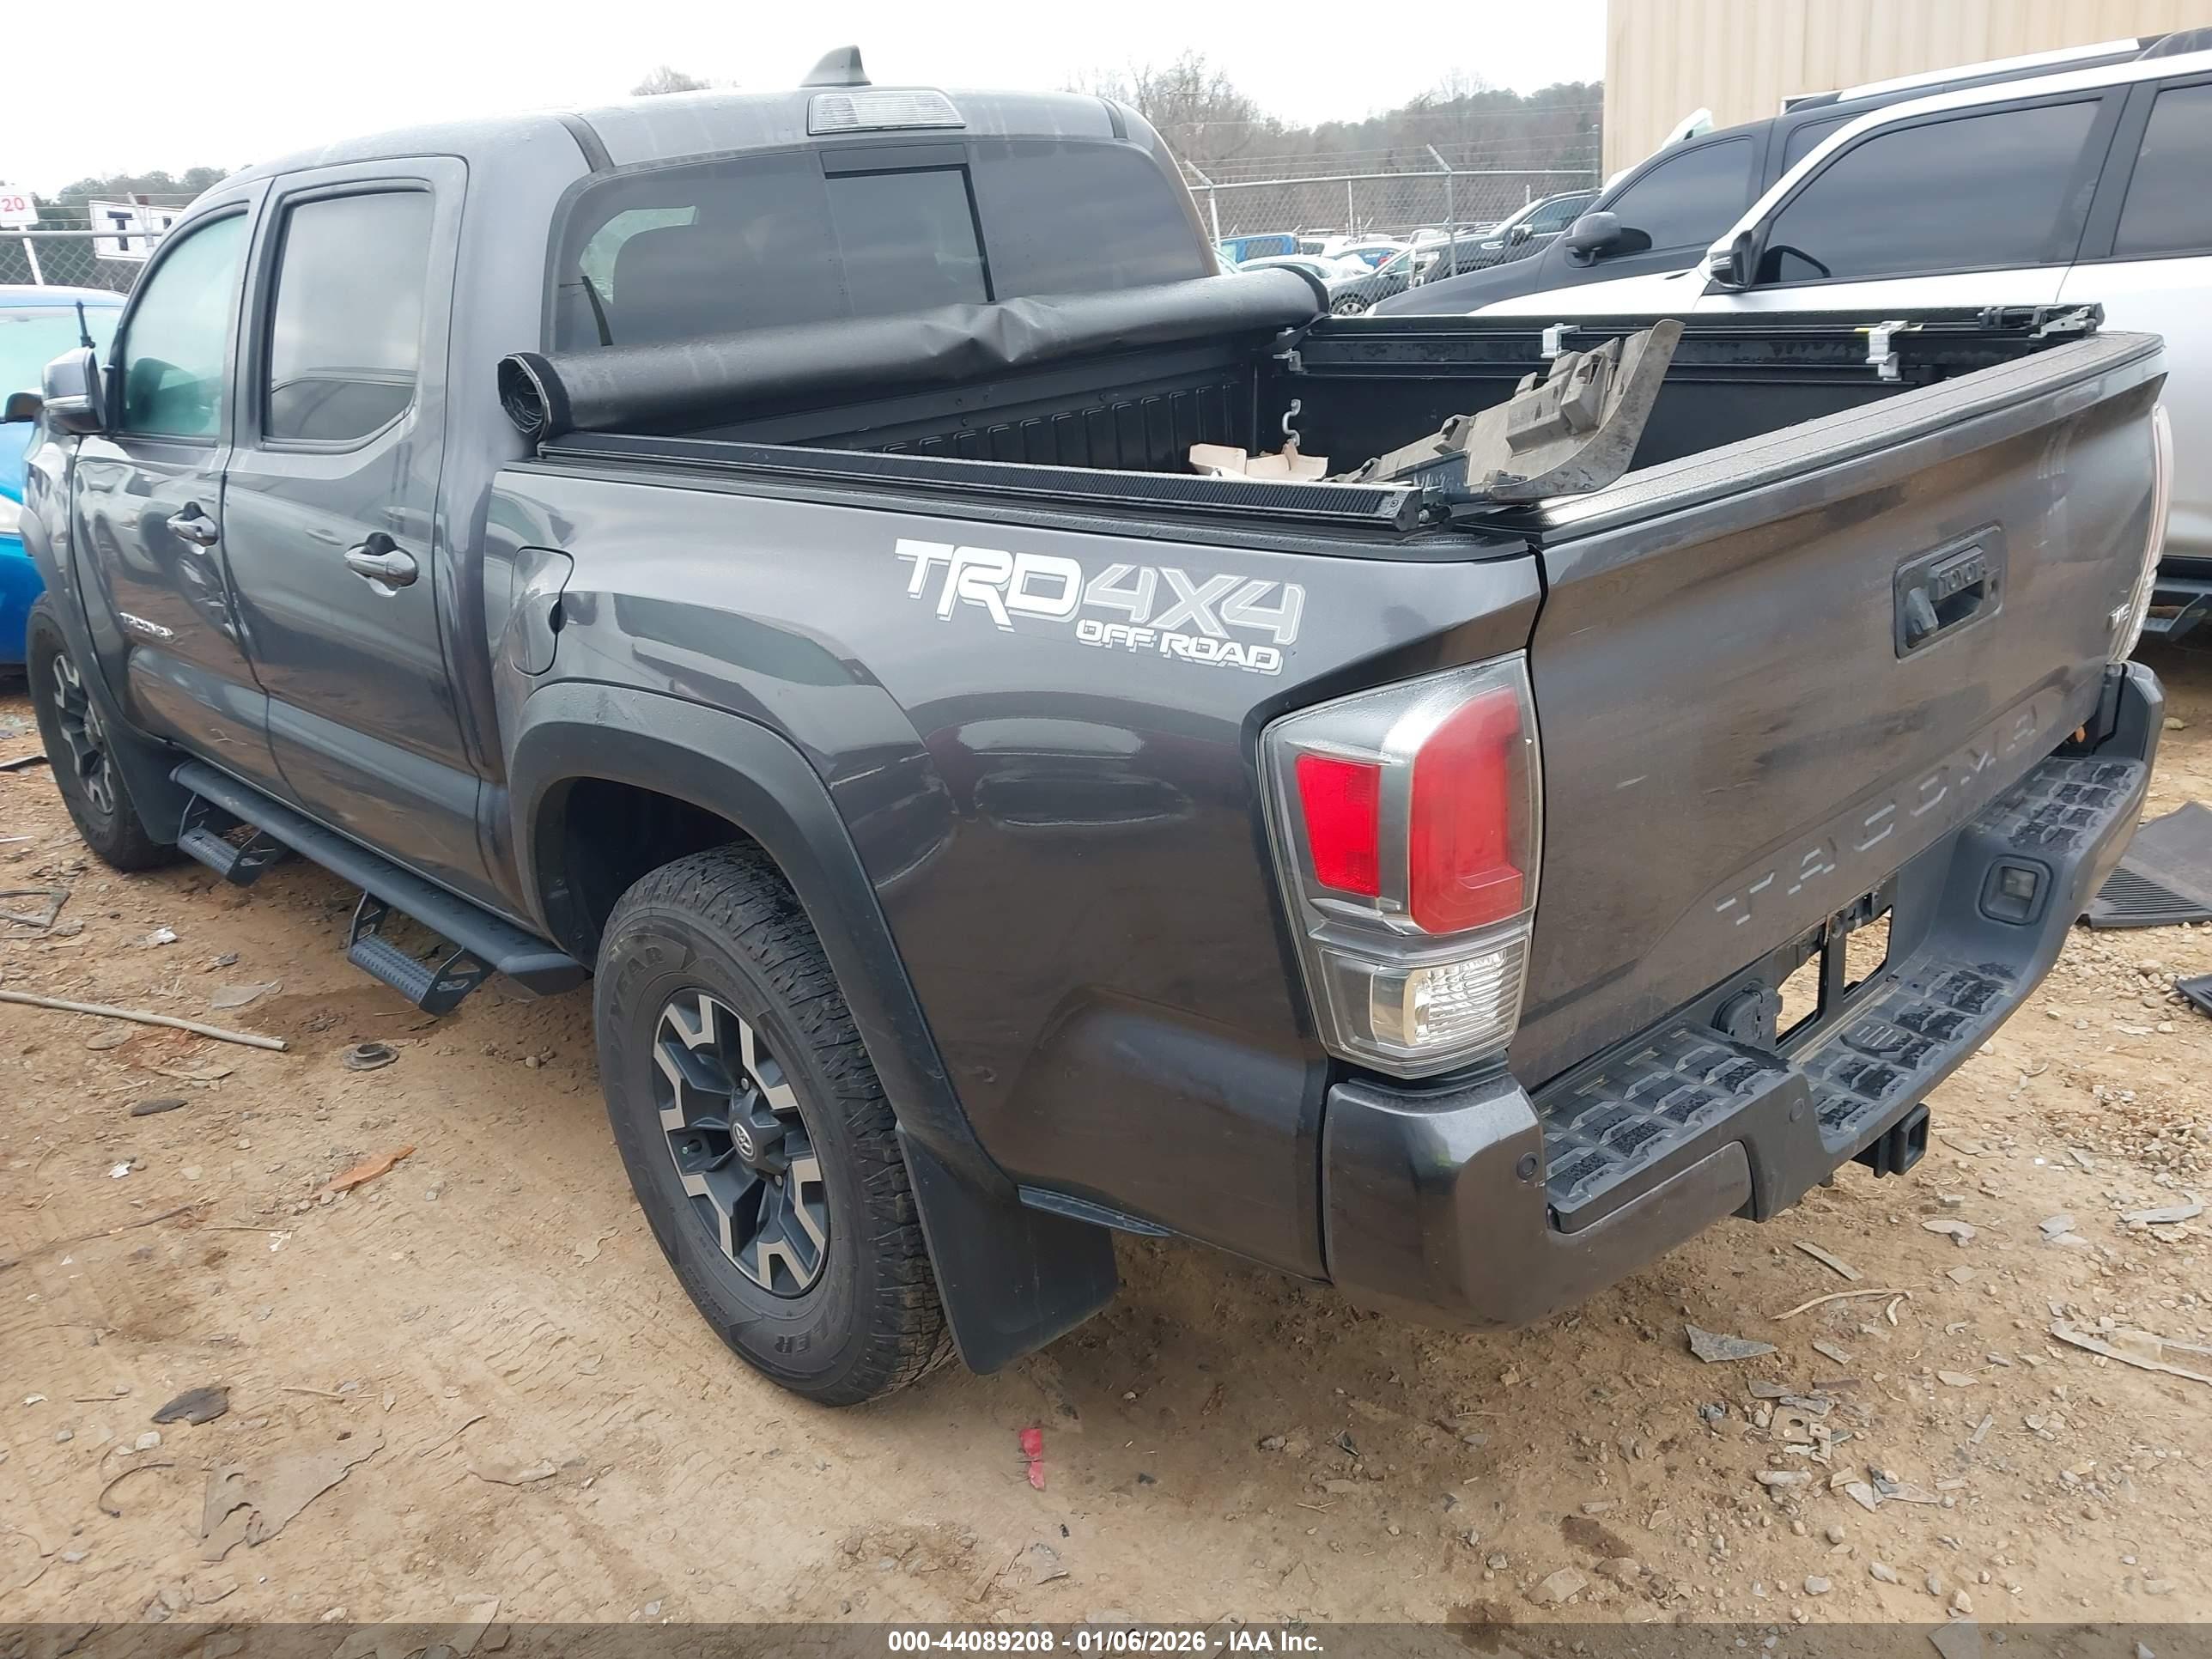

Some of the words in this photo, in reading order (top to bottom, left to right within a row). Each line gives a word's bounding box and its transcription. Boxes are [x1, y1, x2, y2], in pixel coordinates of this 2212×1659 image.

[1, 197, 26, 212] 20
[894, 538, 1085, 632] TRD
[1076, 618, 1158, 653] OFF
[1158, 631, 1284, 677] ROAD
[1714, 702, 2038, 927] TACOMA
